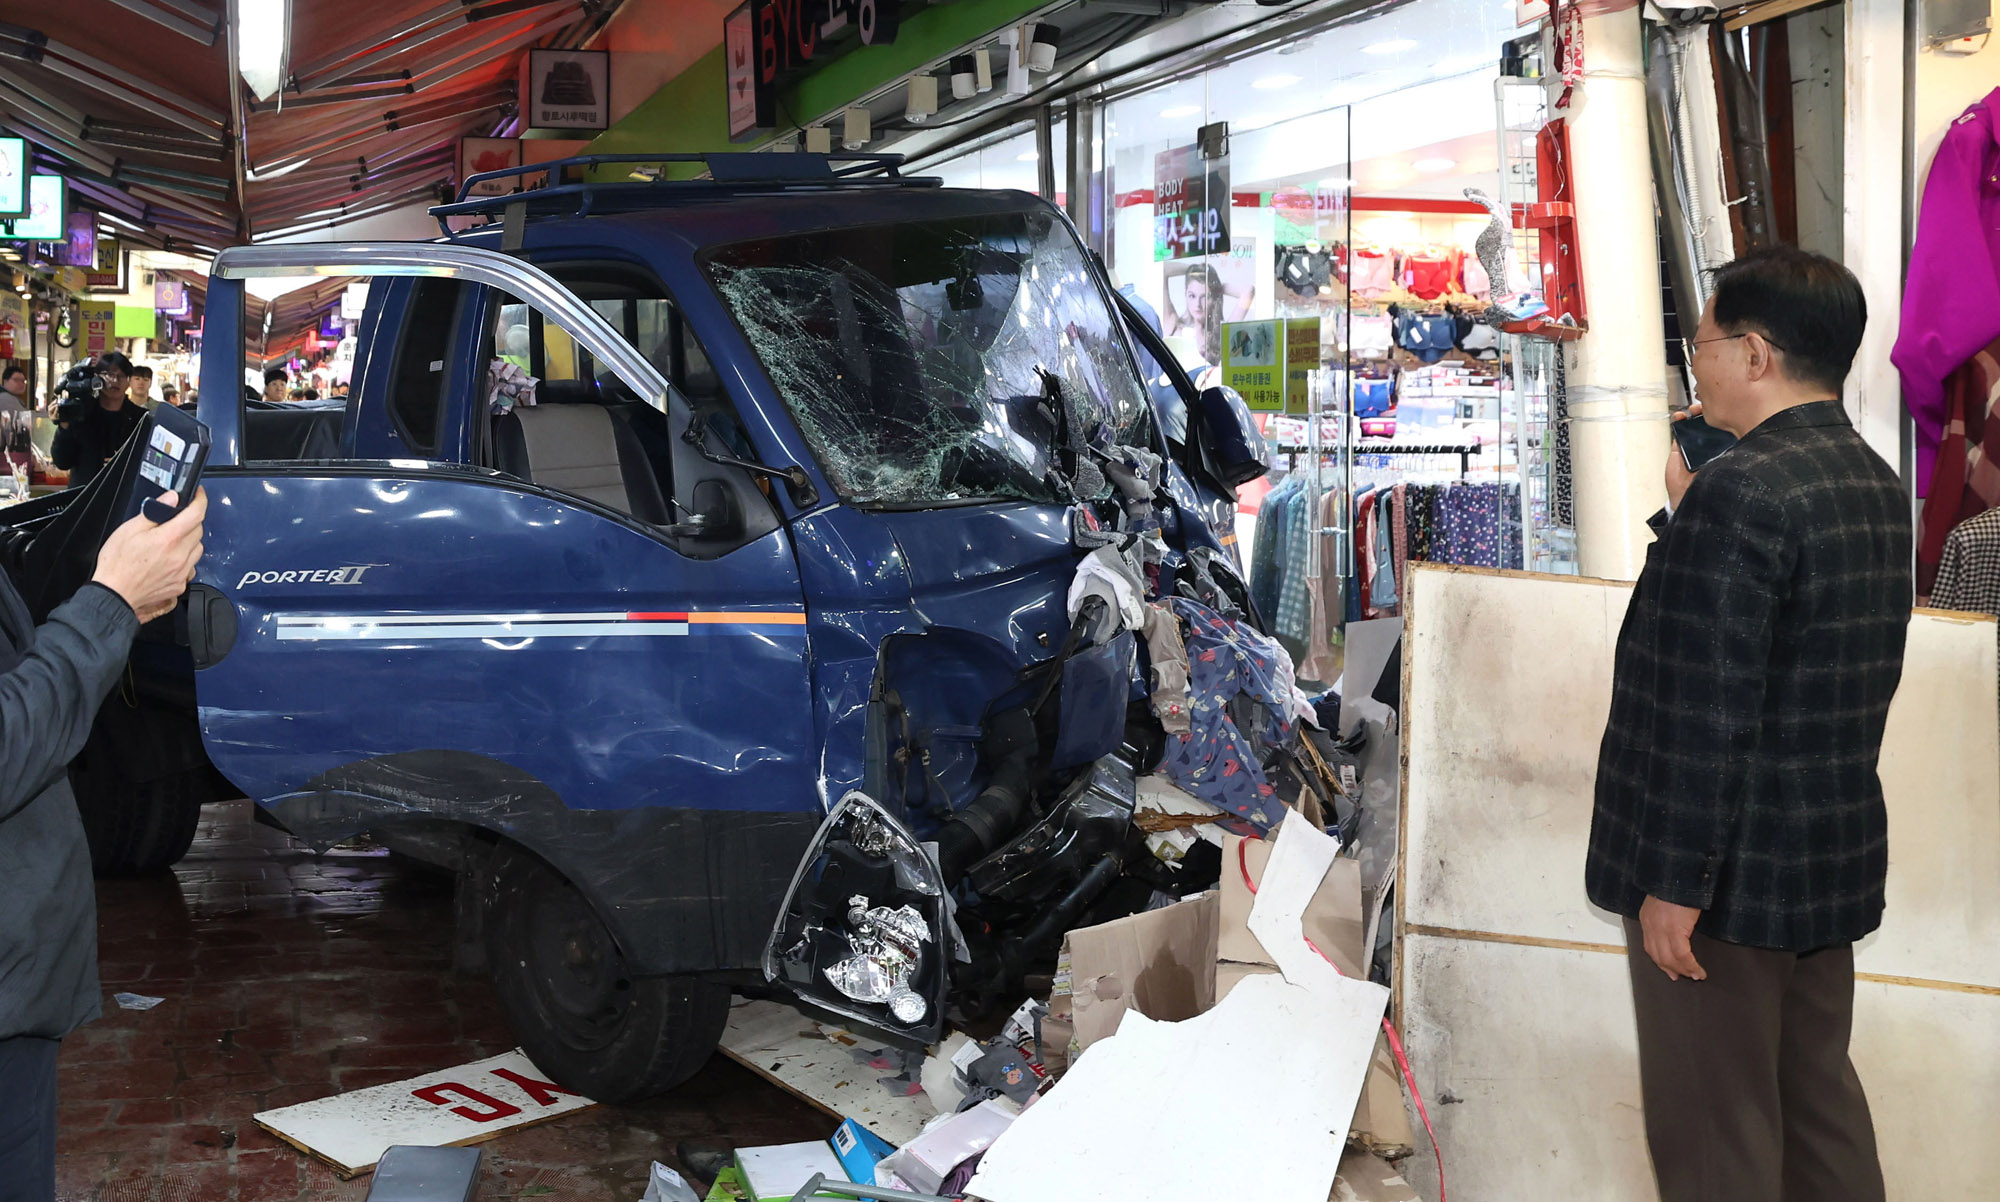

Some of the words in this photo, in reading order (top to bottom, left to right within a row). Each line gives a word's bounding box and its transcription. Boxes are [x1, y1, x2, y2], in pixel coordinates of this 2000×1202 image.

[760, 0, 816, 84] BYC
[1158, 178, 1184, 198] BODY
[1158, 199, 1184, 215] HEAT
[1232, 372, 1271, 386] 온누리상품권
[1253, 390, 1280, 403] 사용가능
[236, 569, 346, 590] PORTER
